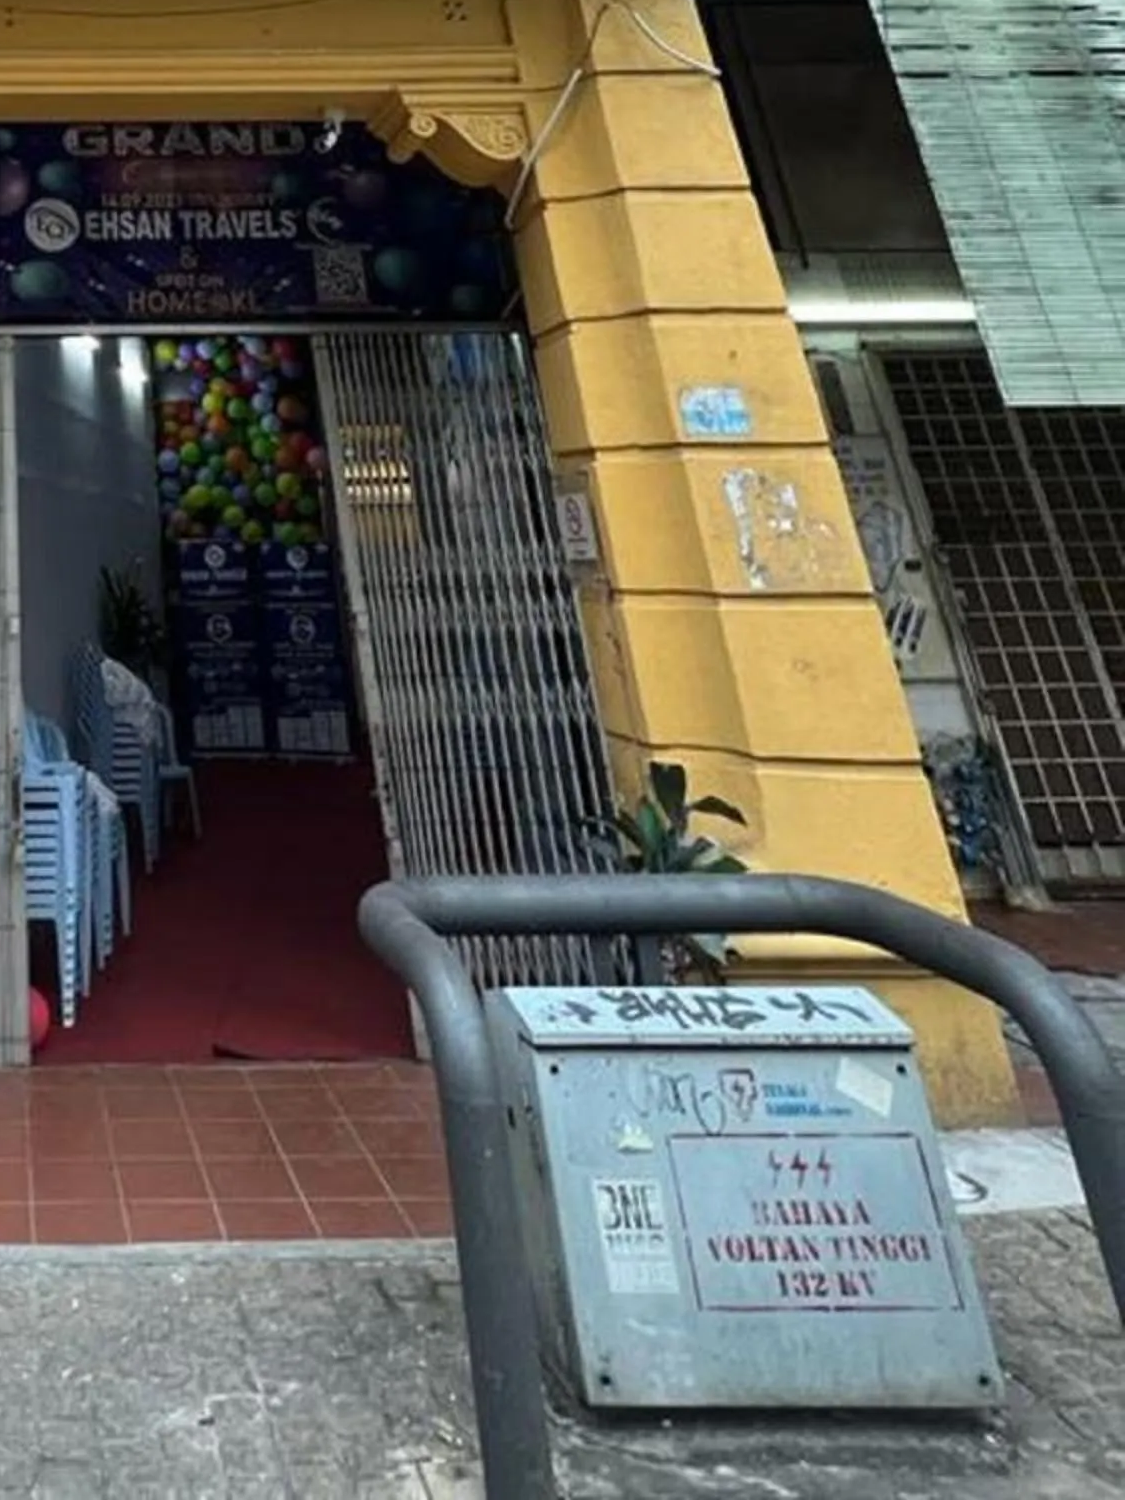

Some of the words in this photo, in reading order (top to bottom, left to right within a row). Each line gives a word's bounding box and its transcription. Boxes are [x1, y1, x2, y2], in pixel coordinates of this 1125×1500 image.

[65, 124, 305, 156] GRAND
[85, 211, 173, 241] EHSAN
[178, 209, 299, 240] TRAVELS
[752, 1199, 872, 1226] BAHAYA
[707, 1235, 821, 1262] VOLTAN
[831, 1235, 932, 1262] TINGGI
[777, 1269, 831, 1298] 132
[836, 1269, 876, 1298] KV
